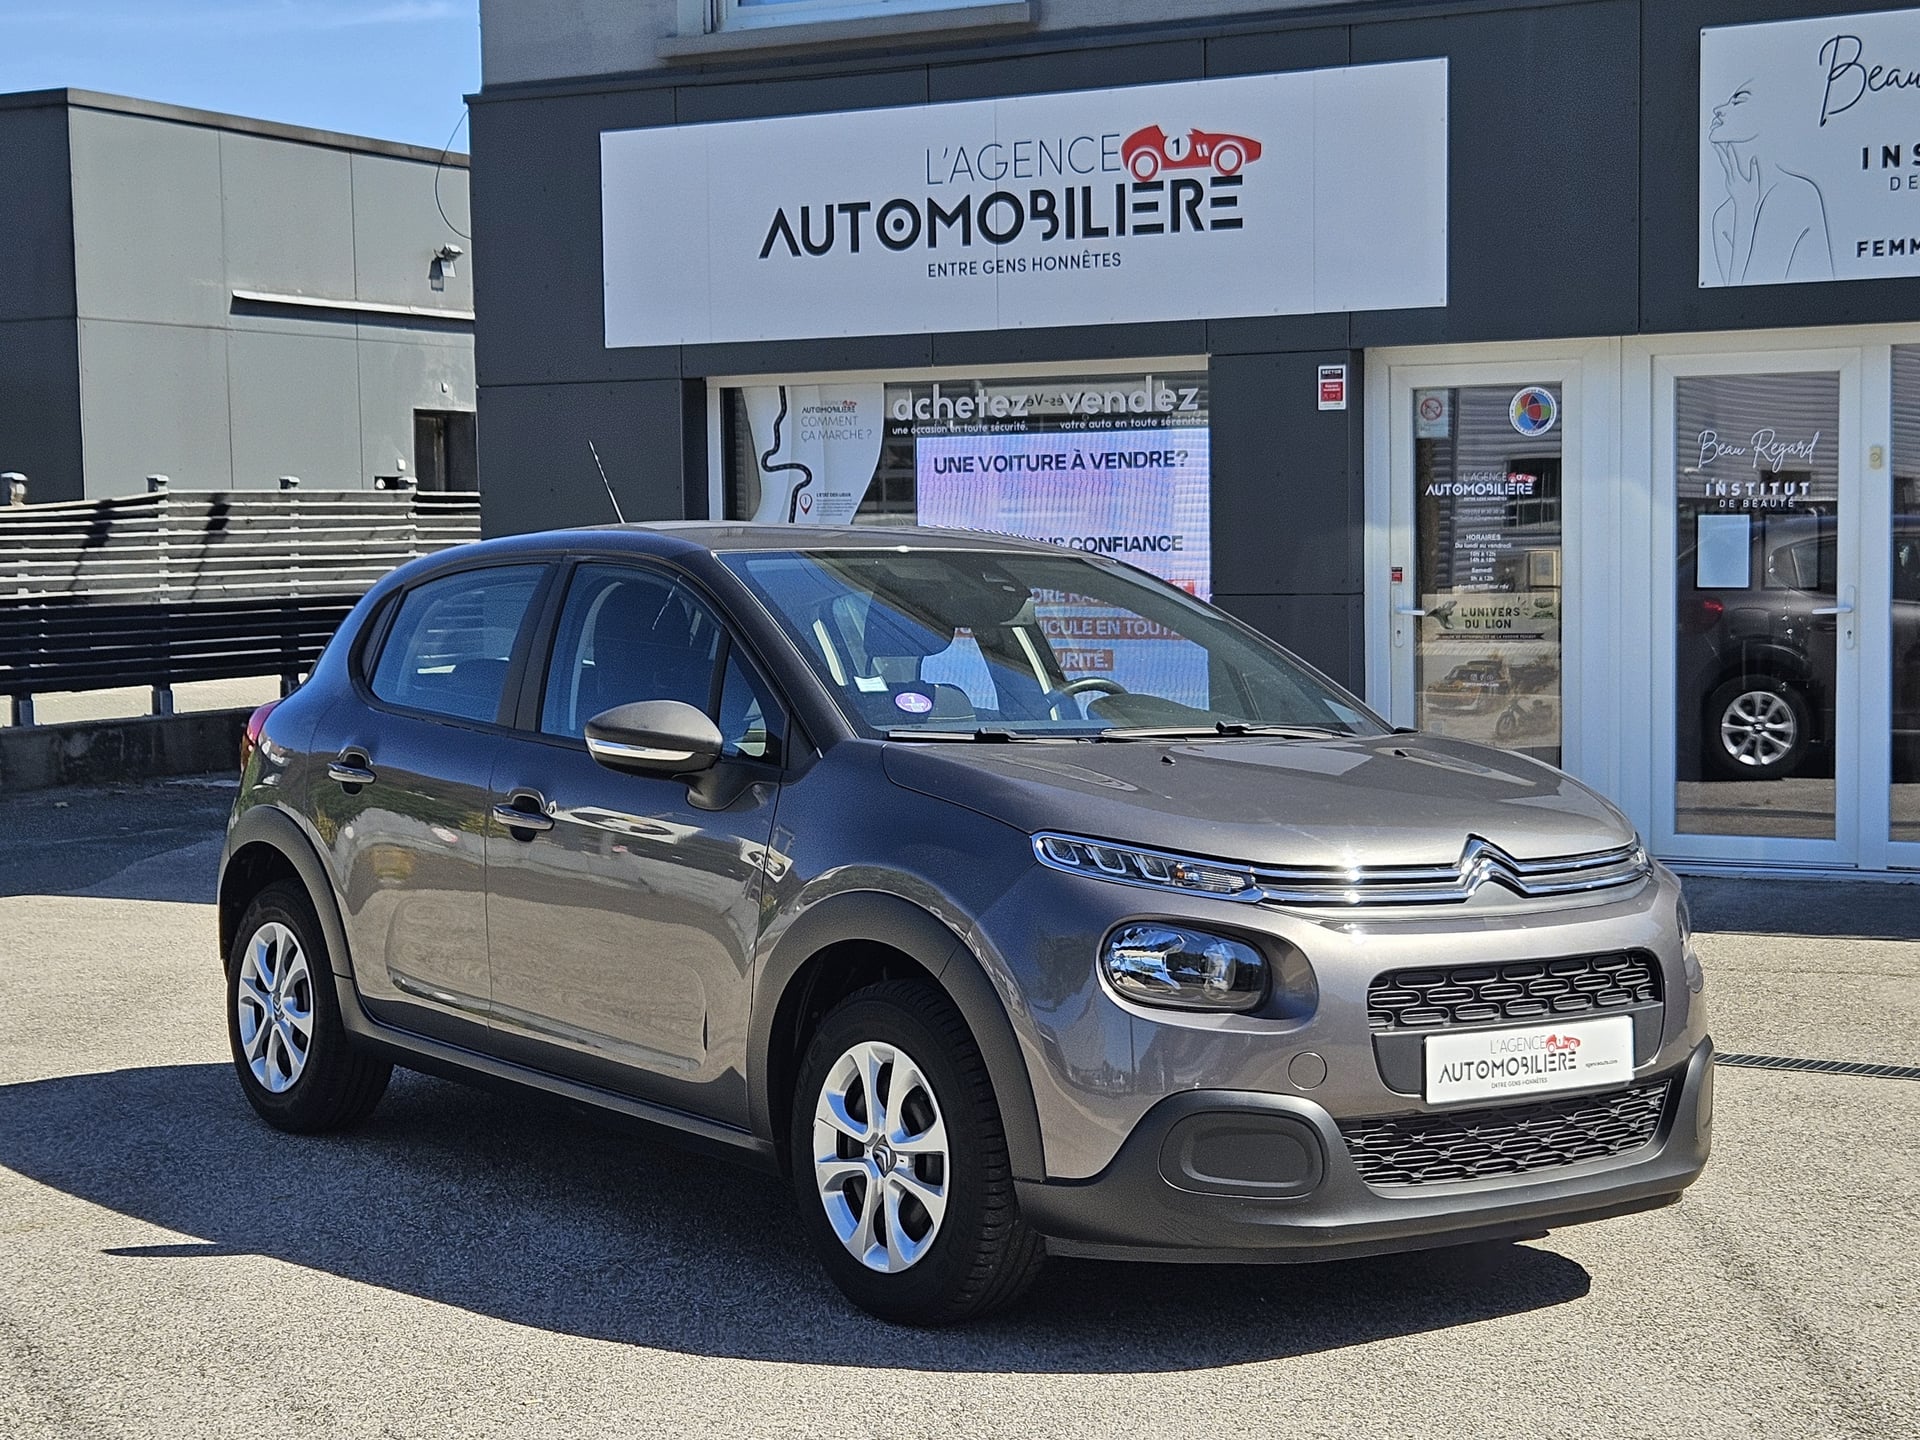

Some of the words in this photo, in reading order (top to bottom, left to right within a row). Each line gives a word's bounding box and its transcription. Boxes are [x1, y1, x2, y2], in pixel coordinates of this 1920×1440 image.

[926, 133, 1121, 185] L'AGENCE
[1890, 175, 1918, 191] DE
[928, 260, 978, 278] ENTRE
[983, 257, 1027, 276] GENS
[1031, 249, 1122, 272] HONNÊTES
[893, 383, 1028, 421] achetez
[1061, 375, 1199, 415] vendez
[801, 416, 858, 427] COMMENT
[892, 427, 908, 435] une
[911, 424, 947, 434] occasion
[950, 425, 961, 433] en
[964, 423, 987, 433] toute
[991, 421, 1028, 432] sécurité.
[1060, 419, 1085, 430] votre
[1088, 418, 1112, 429] auto
[1115, 419, 1127, 428] en
[1130, 417, 1157, 427] toute
[801, 430, 815, 442] ÇA
[819, 429, 864, 440] MARCHE
[1697, 430, 1745, 469] Beau
[1750, 428, 1820, 473] Regard
[934, 456, 974, 474] UNE
[978, 453, 1067, 473] VOITURE
[1070, 449, 1086, 470] À
[1086, 450, 1188, 470] VENDRE?
[1463, 472, 1507, 482] L'AGENCE
[1705, 482, 1811, 496] INSTITUT
[1719, 499, 1735, 508] DE
[1069, 535, 1184, 553] CONFIANCE
[1096, 620, 1120, 635] EN
[1465, 619, 1479, 629] DU
[1485, 619, 1512, 629] LION
[1490, 1035, 1546, 1055] L'AGENCE
